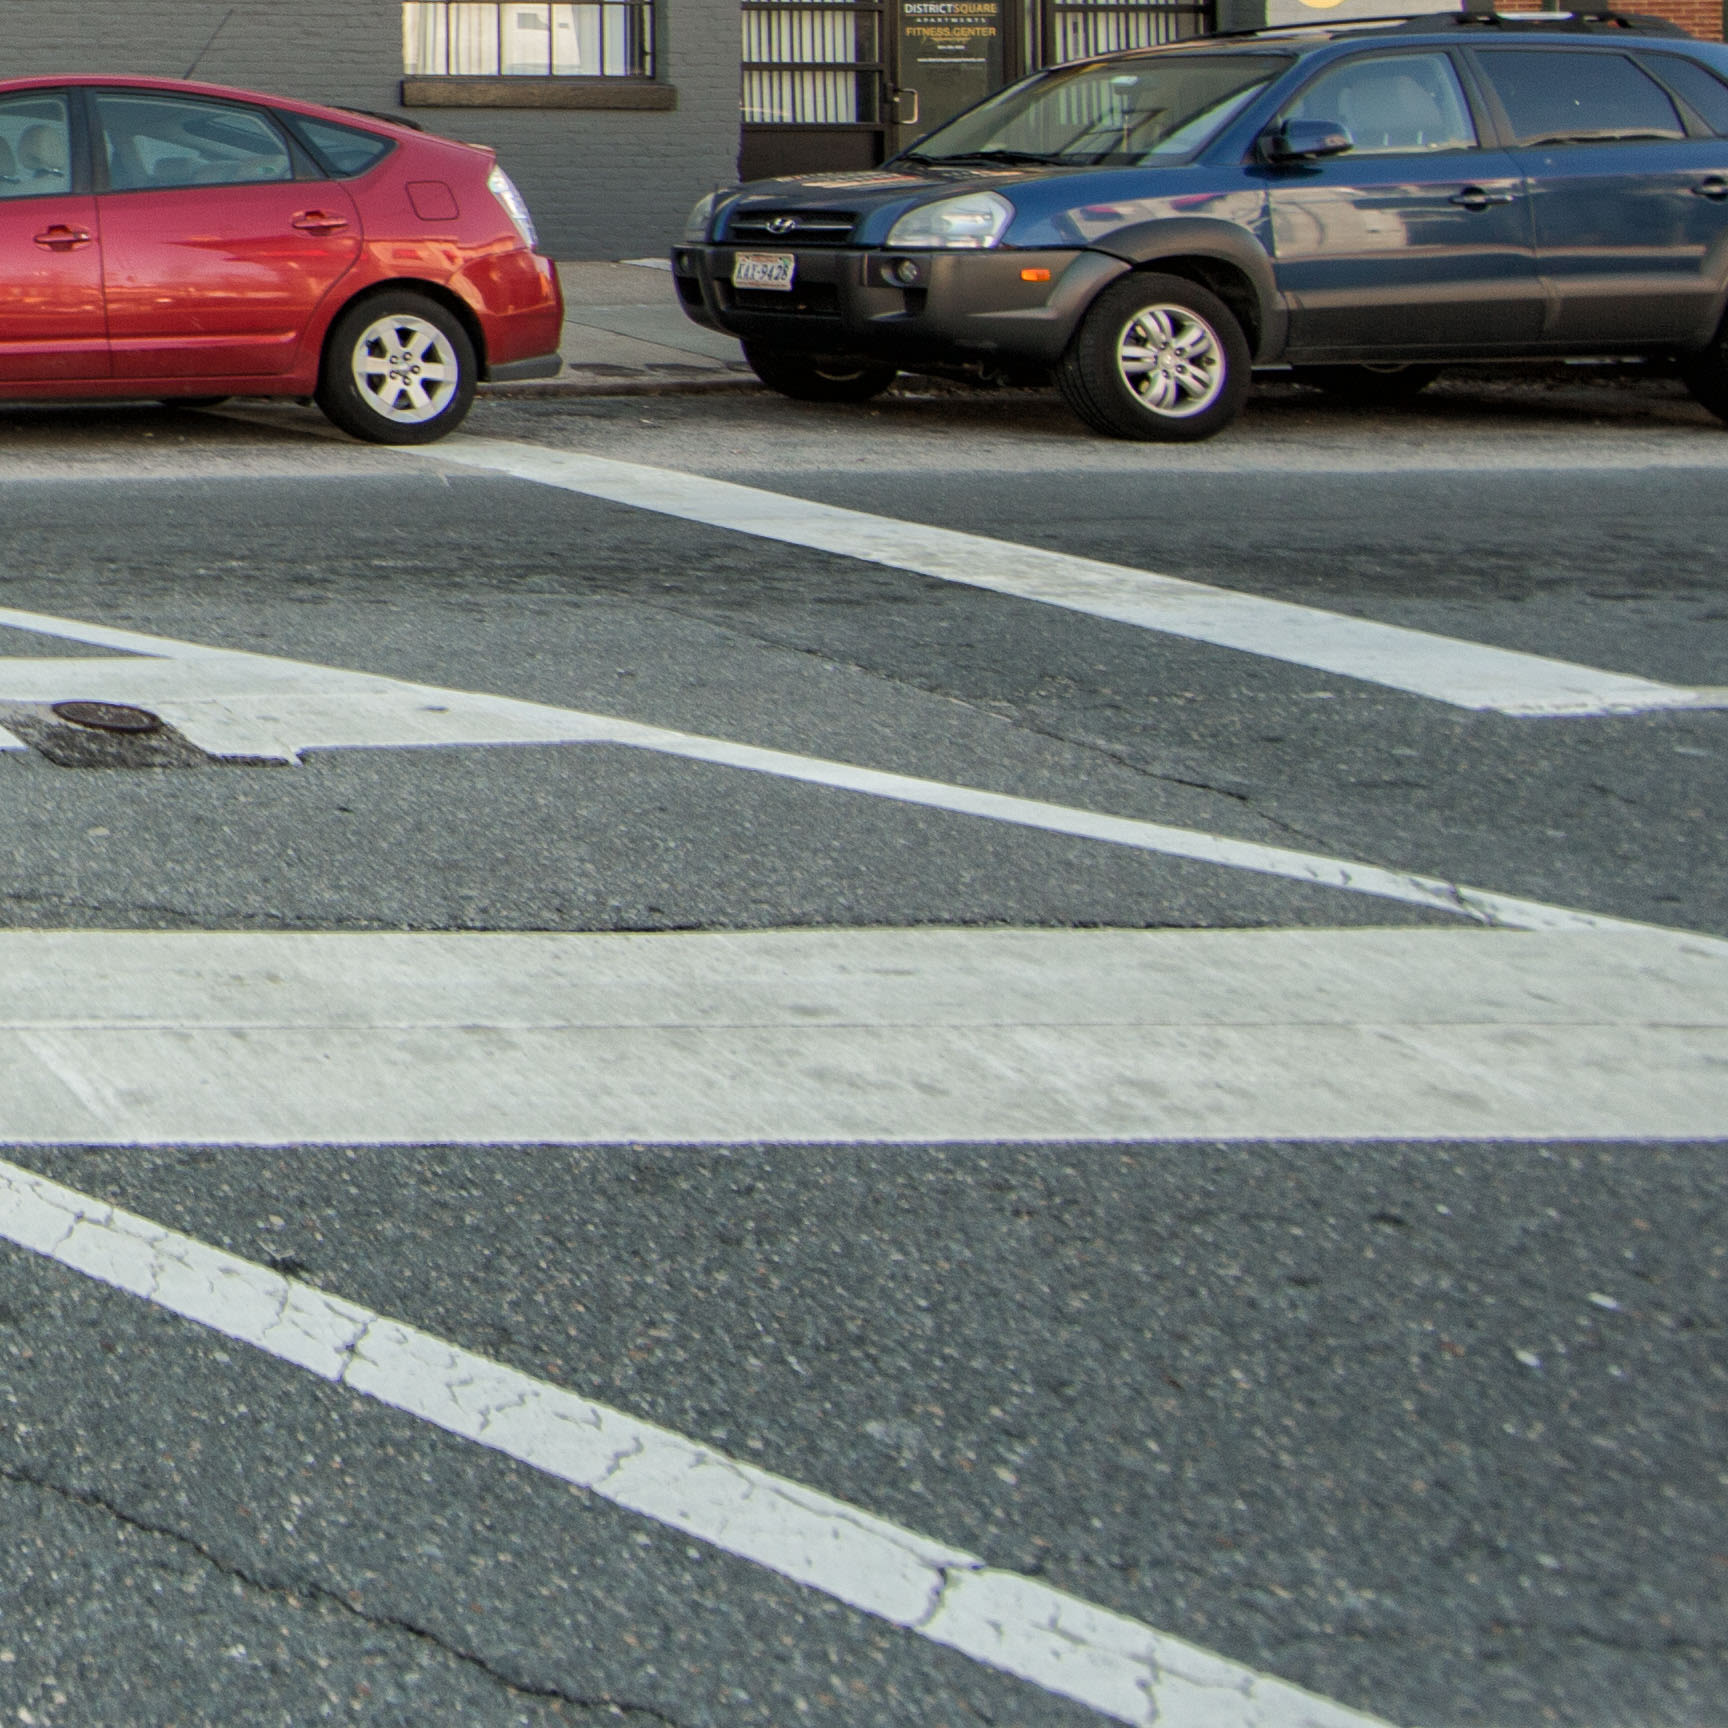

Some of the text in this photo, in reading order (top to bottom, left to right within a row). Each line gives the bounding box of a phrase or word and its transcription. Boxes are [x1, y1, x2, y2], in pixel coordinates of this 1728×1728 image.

[904, 3, 997, 14] DISTRICT SQUARE
[905, 27, 997, 37] FITNESS CENTER
